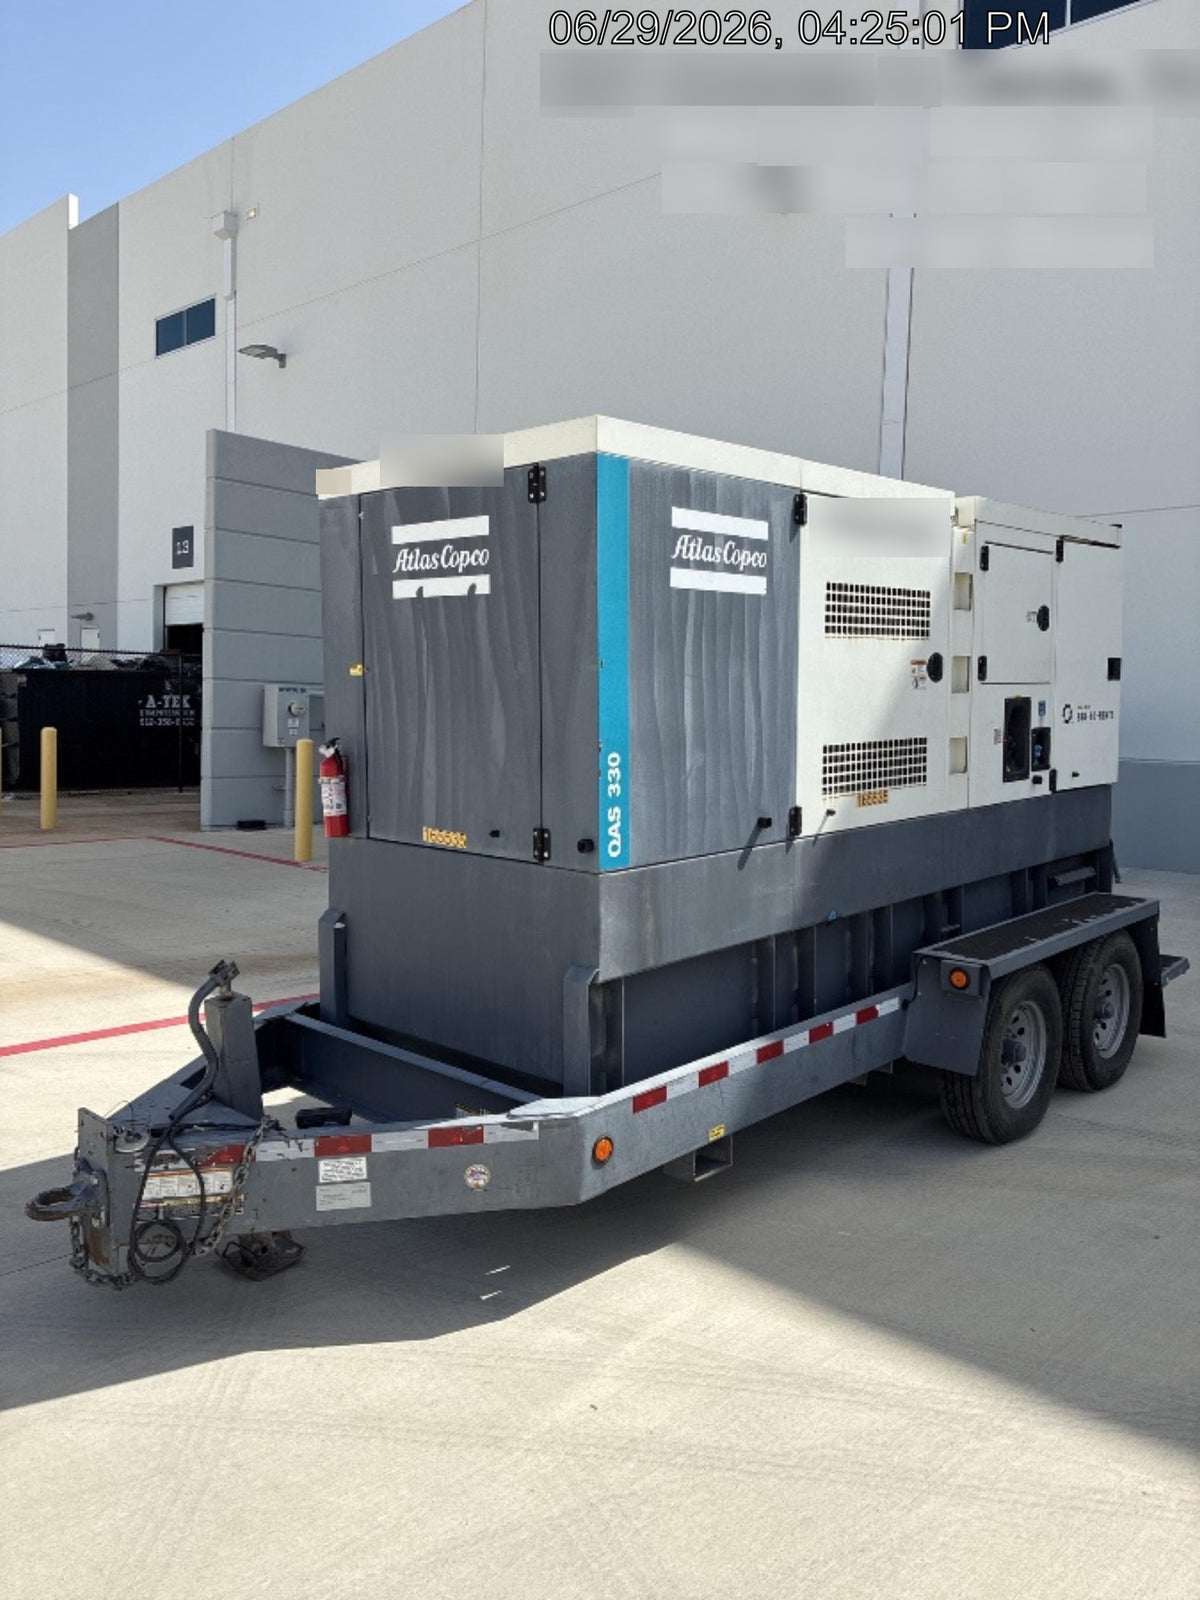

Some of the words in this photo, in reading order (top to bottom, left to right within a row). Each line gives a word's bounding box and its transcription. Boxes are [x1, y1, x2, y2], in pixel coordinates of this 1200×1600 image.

[392, 547, 440, 573] Atlas
[440, 544, 490, 573] Copco
[671, 534, 721, 563] Atlas
[722, 541, 768, 571] Copco
[607, 752, 621, 798] 330
